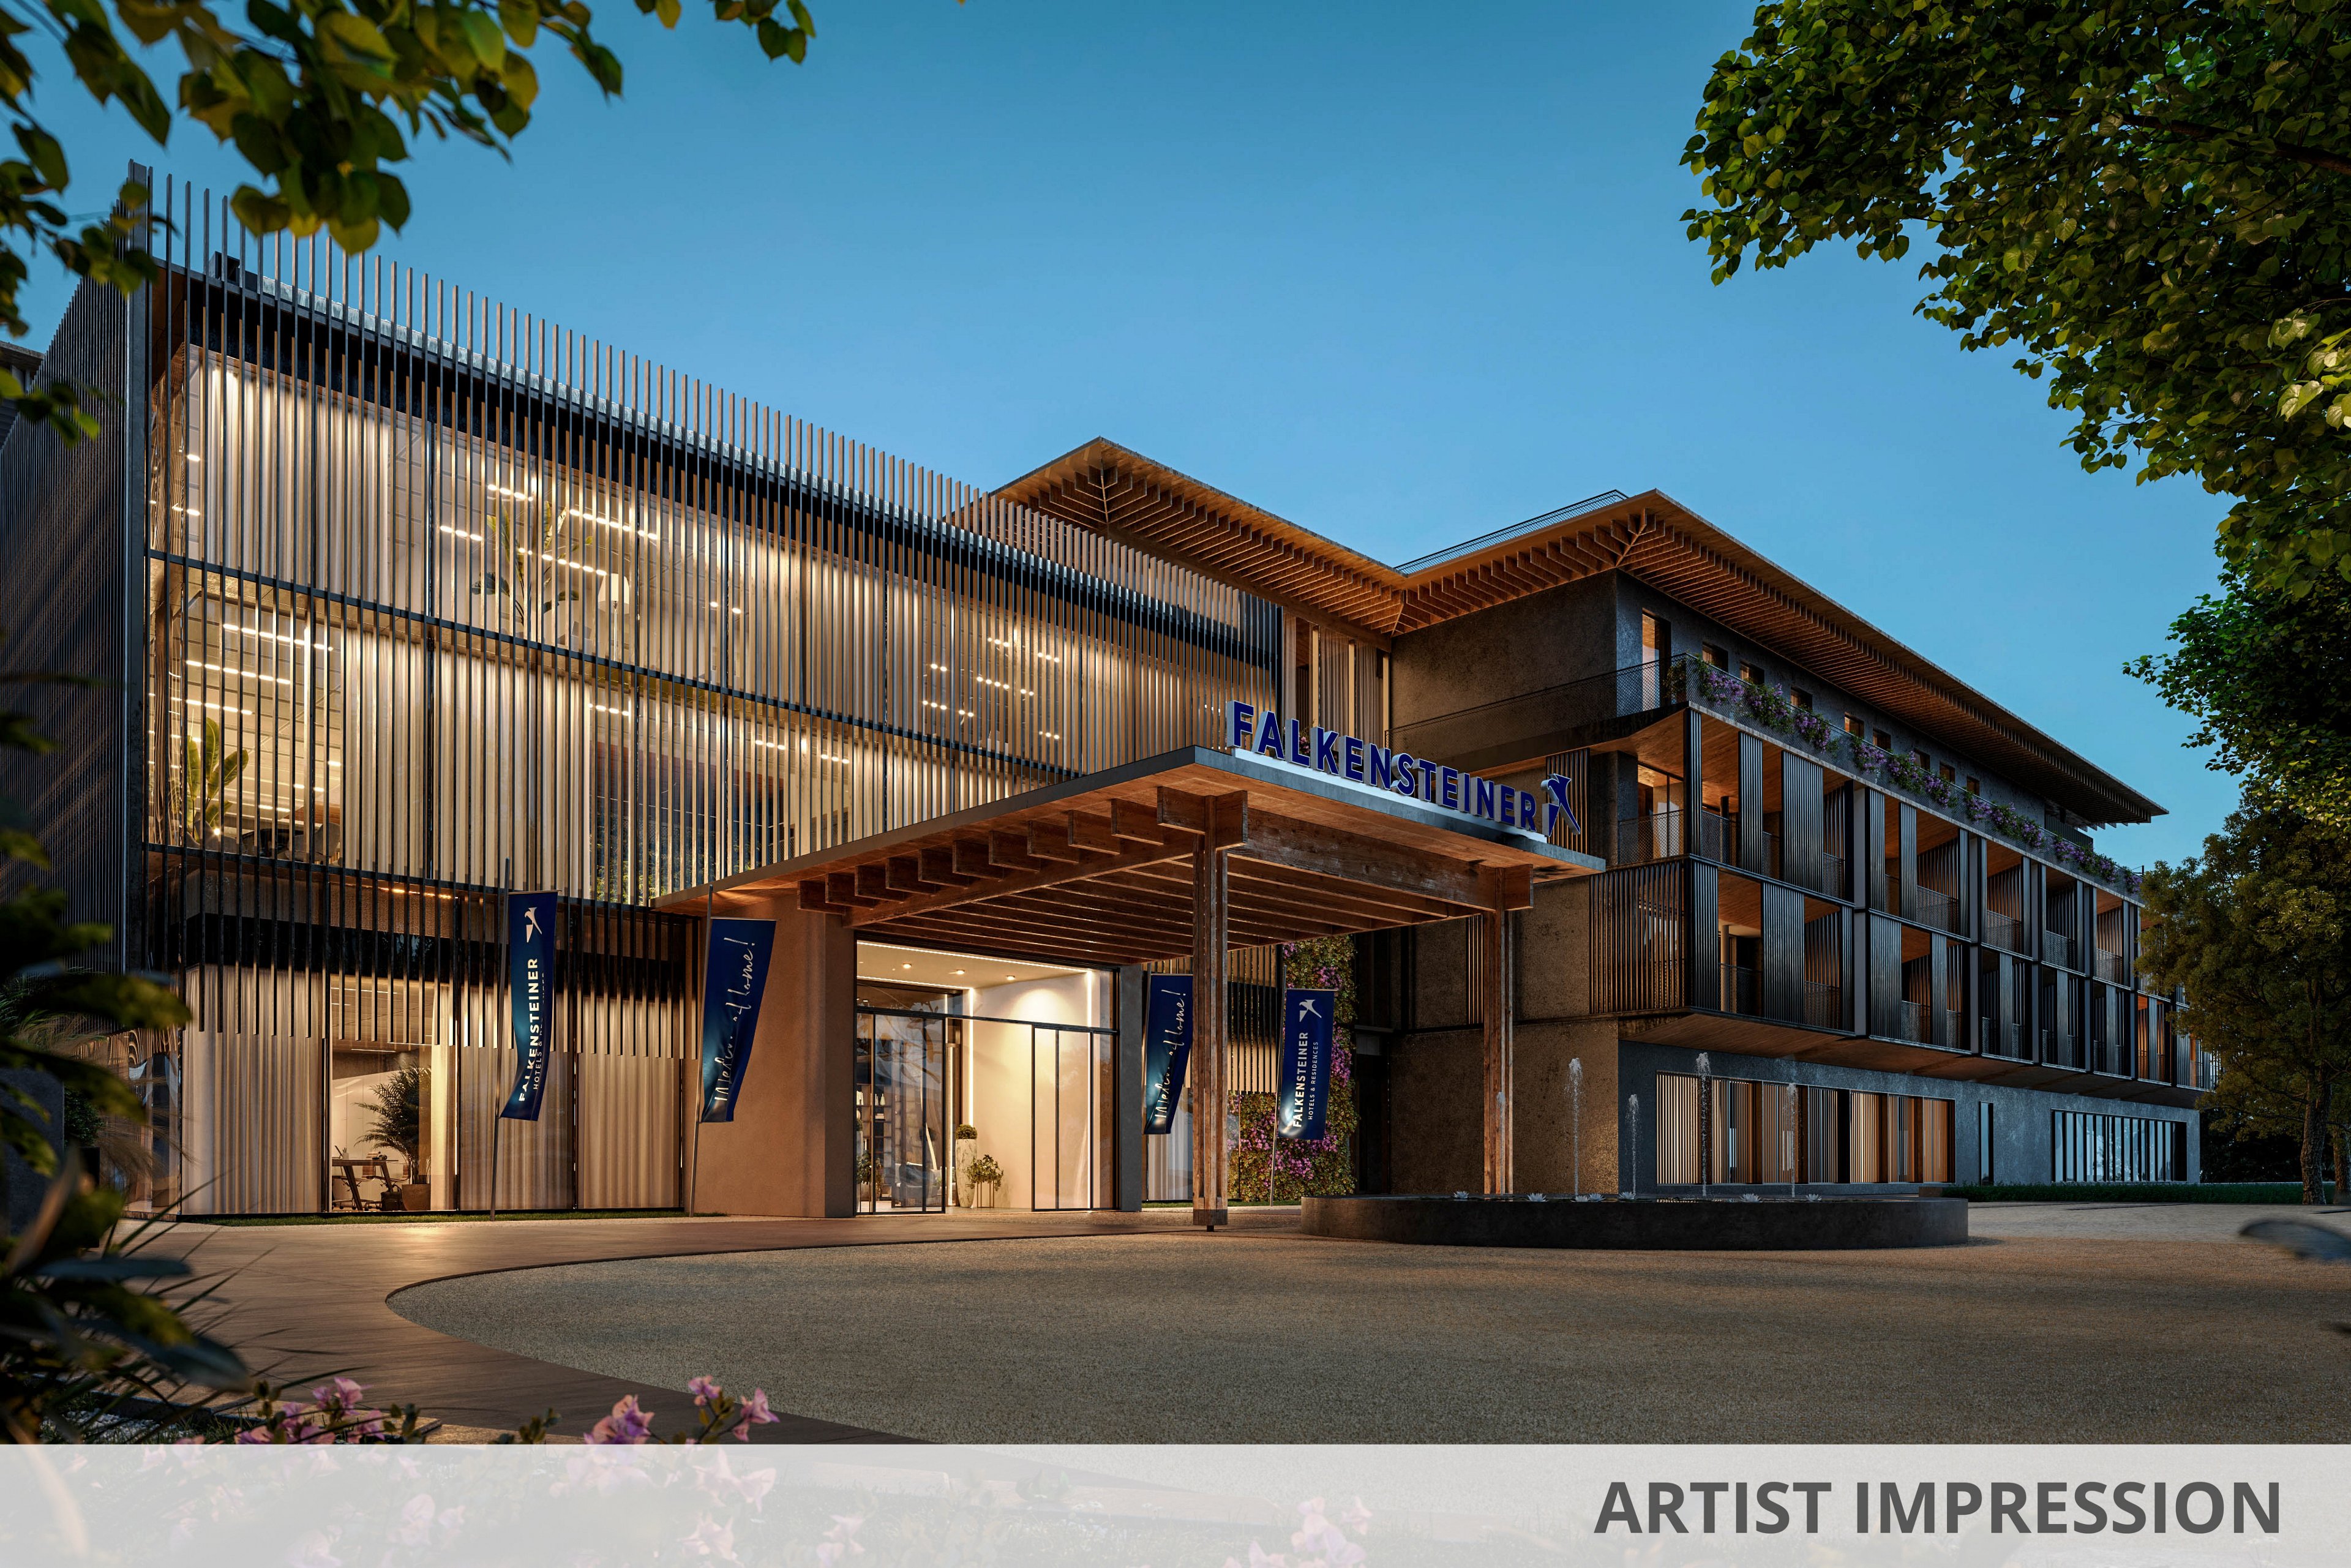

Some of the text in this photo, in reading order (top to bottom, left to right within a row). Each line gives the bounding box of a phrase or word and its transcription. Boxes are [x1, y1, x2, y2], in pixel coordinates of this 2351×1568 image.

[1227, 700, 1537, 833] FALKENSTEINER
[533, 1051, 542, 1089] HOTELS
[1292, 1032, 1308, 1127] FALKENSTEINER
